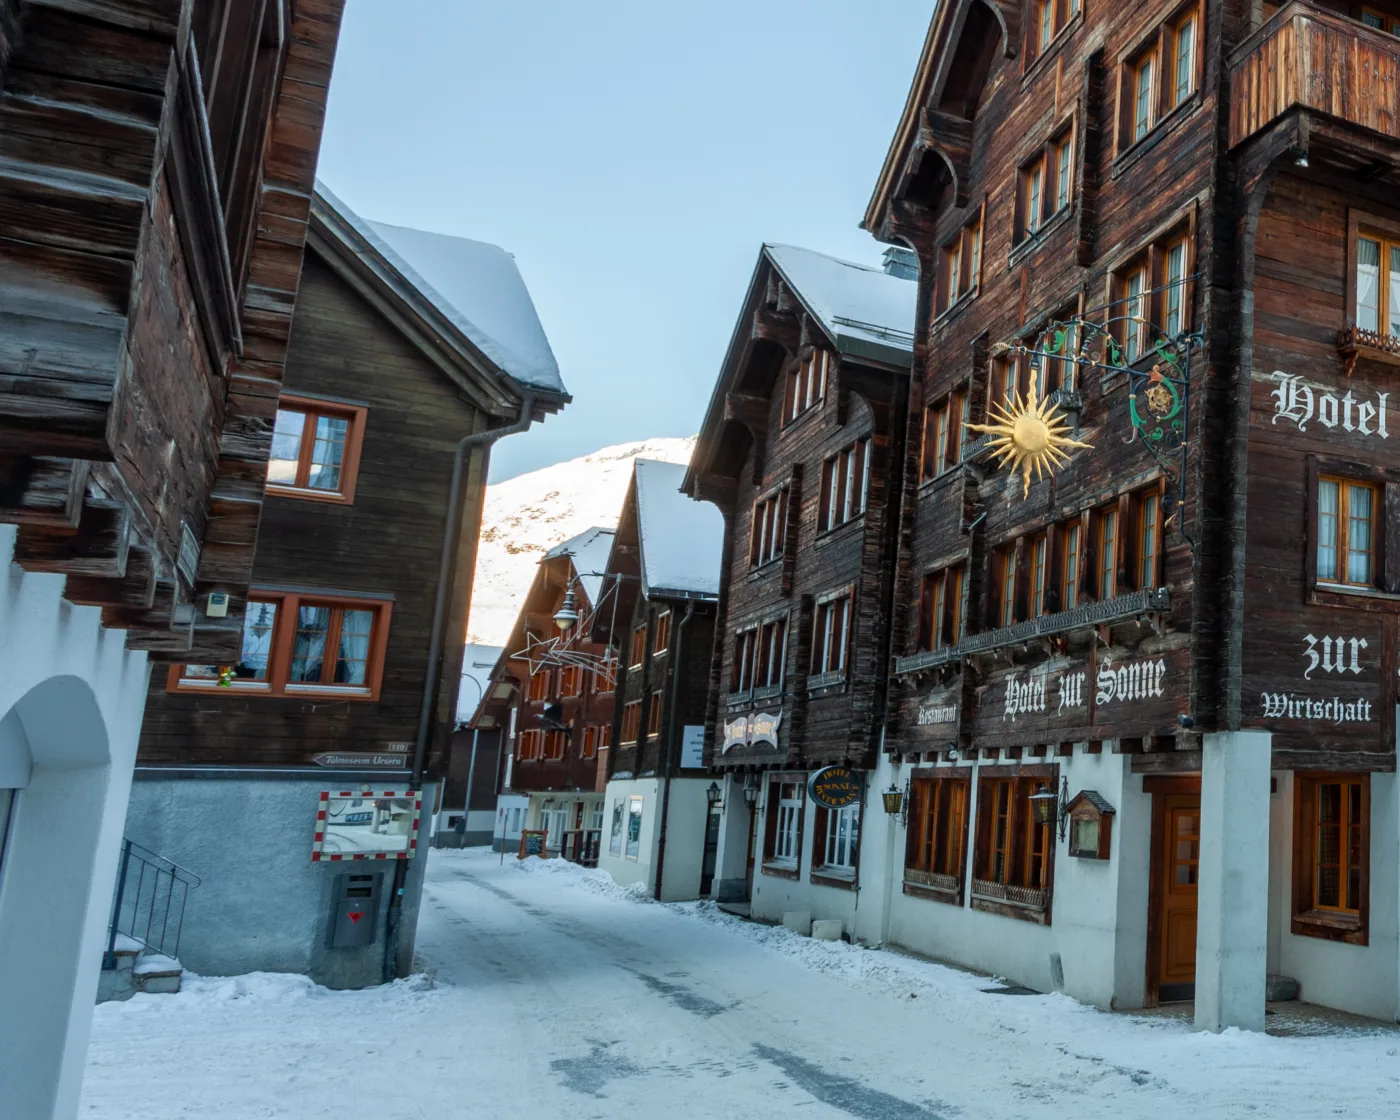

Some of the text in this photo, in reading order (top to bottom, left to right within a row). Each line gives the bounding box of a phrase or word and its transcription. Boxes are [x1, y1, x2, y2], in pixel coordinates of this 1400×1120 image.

[1270, 370, 1390, 439] Hotel
[1302, 633, 1368, 680] zur
[1003, 655, 1166, 722] Hotel zur Sonne
[1261, 692, 1372, 724] Wirtschaft
[917, 704, 957, 726] Restaurant
[373, 755, 402, 765] Ursern
